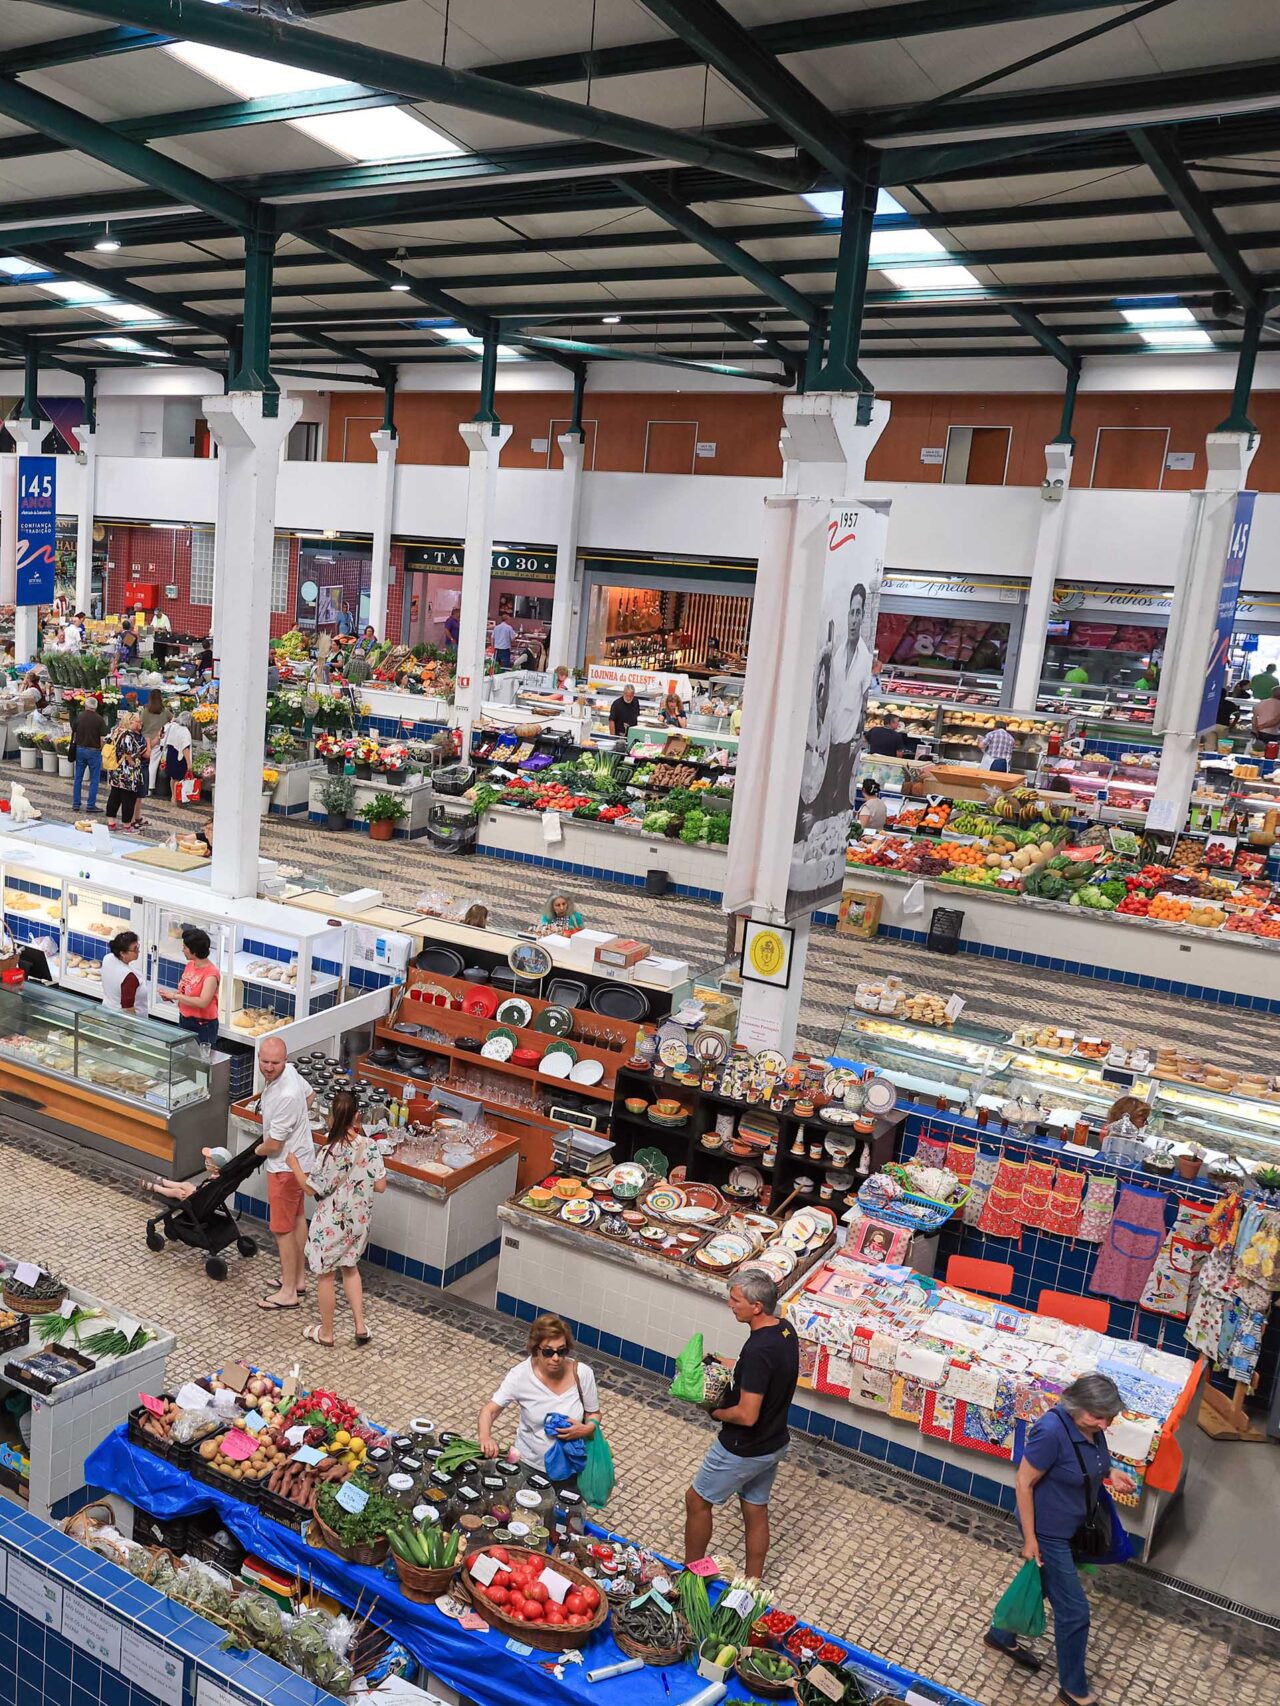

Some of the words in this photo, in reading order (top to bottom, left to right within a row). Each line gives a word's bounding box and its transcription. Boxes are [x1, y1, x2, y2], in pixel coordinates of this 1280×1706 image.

[21, 474, 53, 498] 145
[22, 497, 52, 509] ANOS
[21, 522, 52, 530] CONFIANÇA
[840, 512, 859, 528] 1957
[25, 526, 52, 534] TRADIÇÃO
[515, 557, 538, 571] 30
[591, 668, 618, 681] LOJINHA
[619, 673, 627, 682] da
[627, 673, 657, 685] CELESTE
